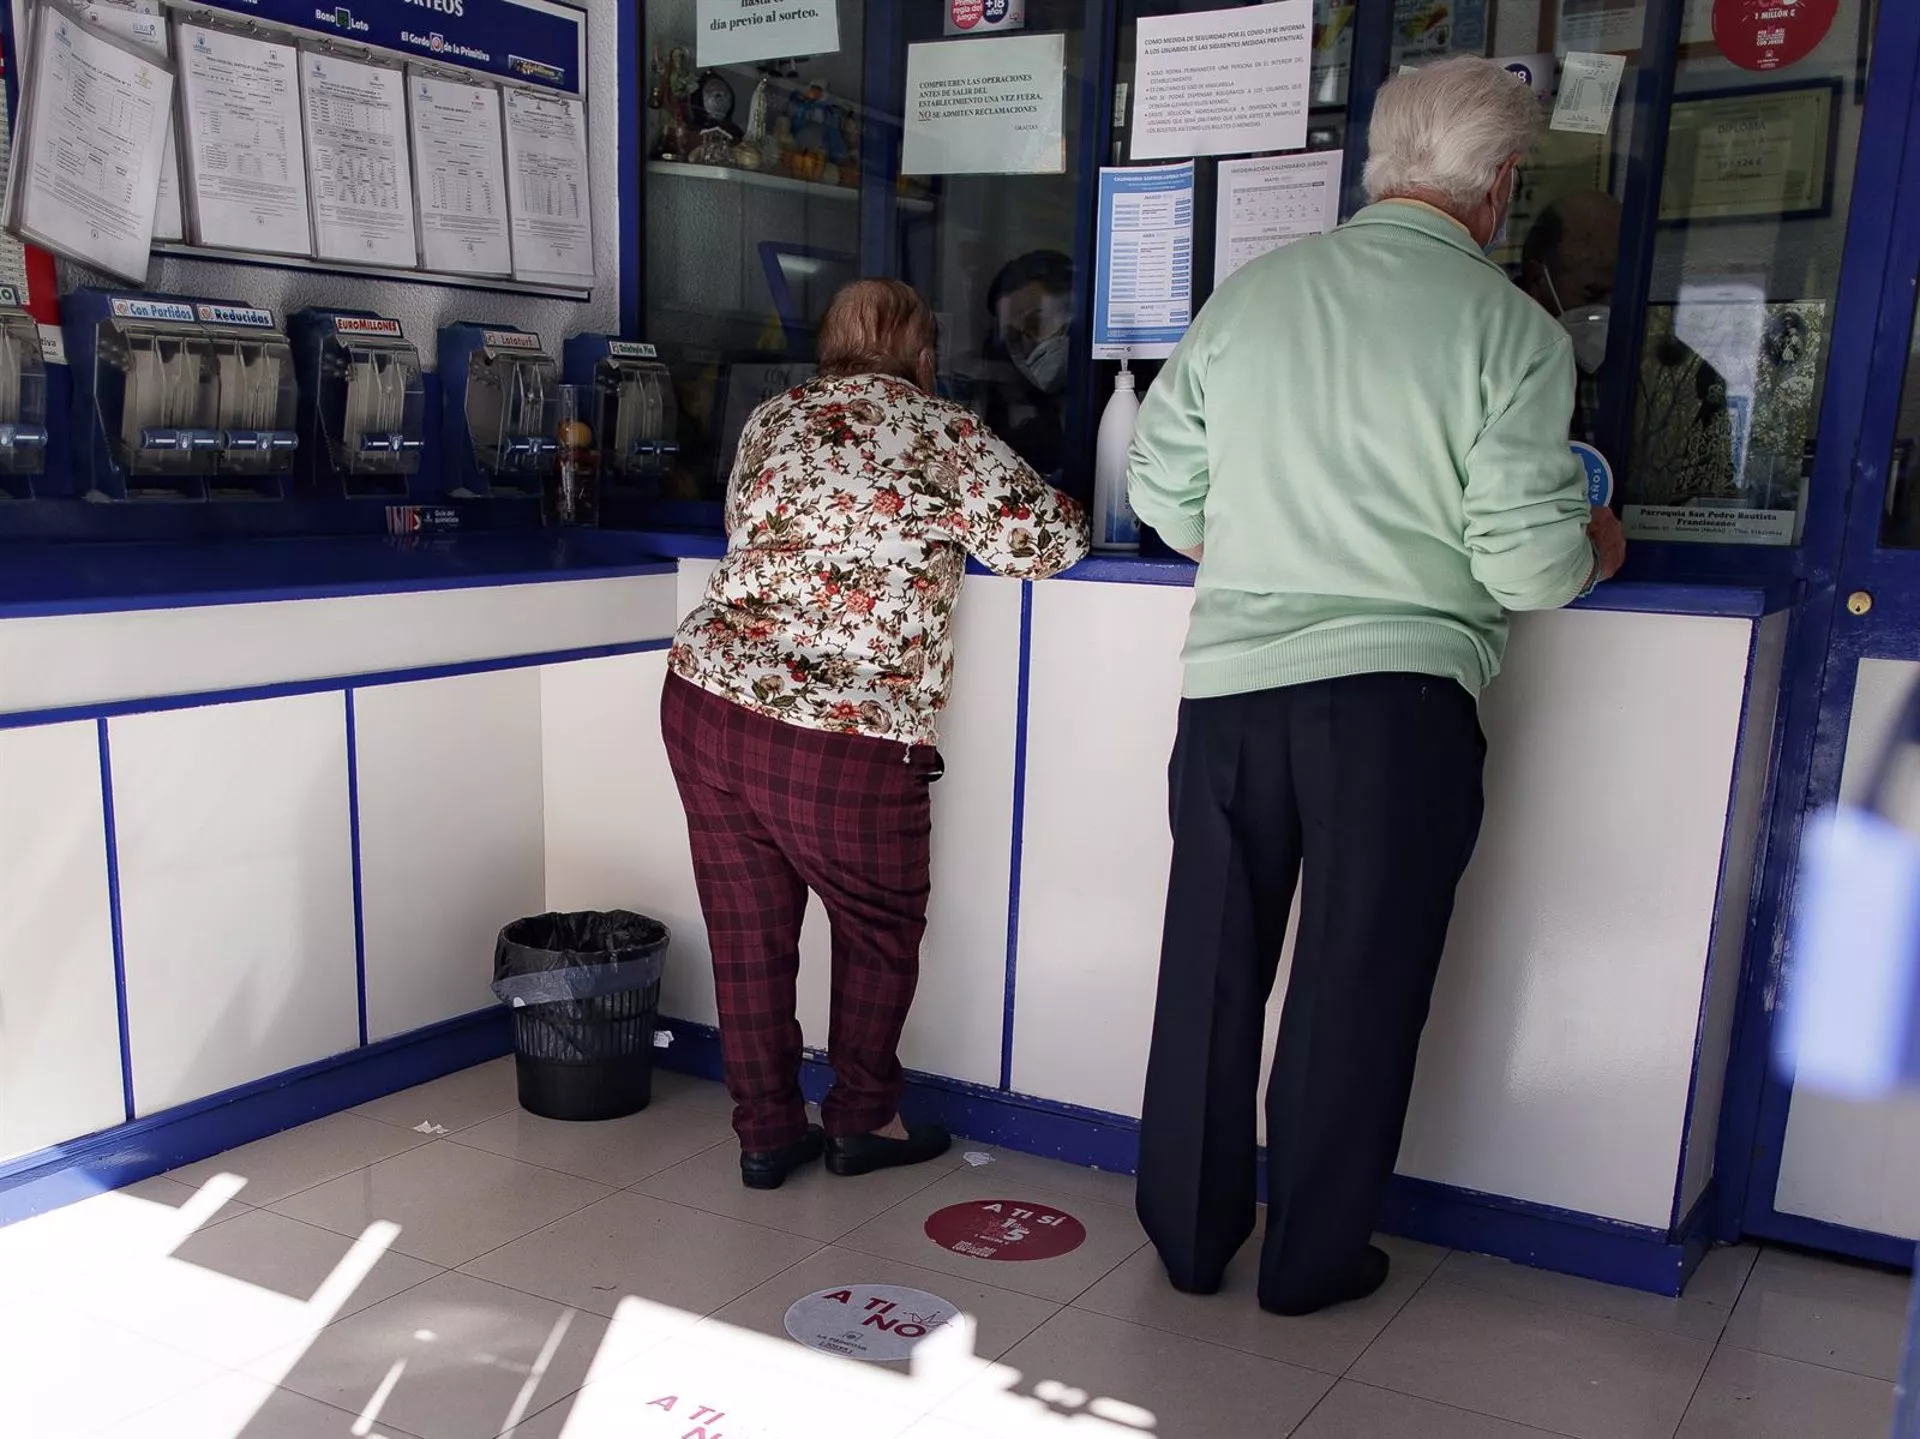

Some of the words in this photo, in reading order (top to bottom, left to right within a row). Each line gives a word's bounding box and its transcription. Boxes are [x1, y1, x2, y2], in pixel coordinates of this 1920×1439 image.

[953, 6, 970, 15] regla
[1761, 9, 1788, 19] MILLÓN
[315, 8, 336, 22] Bono
[351, 18, 369, 32] Loto
[710, 19, 726, 30] día
[730, 13, 763, 31] previo
[766, 11, 776, 23] al
[779, 9, 818, 20] sorteo.
[1163, 35, 1185, 44] MEDIDA
[1194, 31, 1226, 40] SEGURIDAD
[1246, 27, 1271, 35] COVID-19
[402, 31, 408, 42] El
[409, 33, 430, 48] Gordo
[444, 41, 452, 52] de
[453, 43, 460, 54] la
[461, 44, 490, 62] Primitiva
[1208, 40, 1240, 49] SIGUIENTES
[919, 79, 966, 89] COMPRUEBEN
[982, 74, 1032, 84] OPERACIONES
[918, 97, 983, 108] ESTABLECIMIENTO
[918, 111, 931, 120] NO
[942, 109, 974, 118] ADMITEN
[975, 106, 1037, 116] RECLAMACIONES
[1718, 122, 1766, 134] DIPLOMA
[130, 303, 149, 316] Con
[152, 305, 191, 319] Partidos
[214, 308, 270, 324] Reducidas
[501, 335, 533, 346] Lototurf
[1591, 468, 1602, 500] AÑOS
[1640, 509, 1686, 518] Parroquia
[1689, 510, 1705, 518] San
[1708, 511, 1735, 519] Pedro
[1738, 512, 1777, 520] Bautista
[1677, 518, 1736, 527] Franciscanos
[982, 1203, 1002, 1213] A
[1011, 1208, 1034, 1219] TI
[1036, 1214, 1067, 1226] SÍ
[822, 1289, 852, 1304] A
[864, 1297, 898, 1314] TI
[862, 1314, 926, 1338] NO
[646, 1395, 679, 1412] A
[688, 1405, 726, 1425] TI
